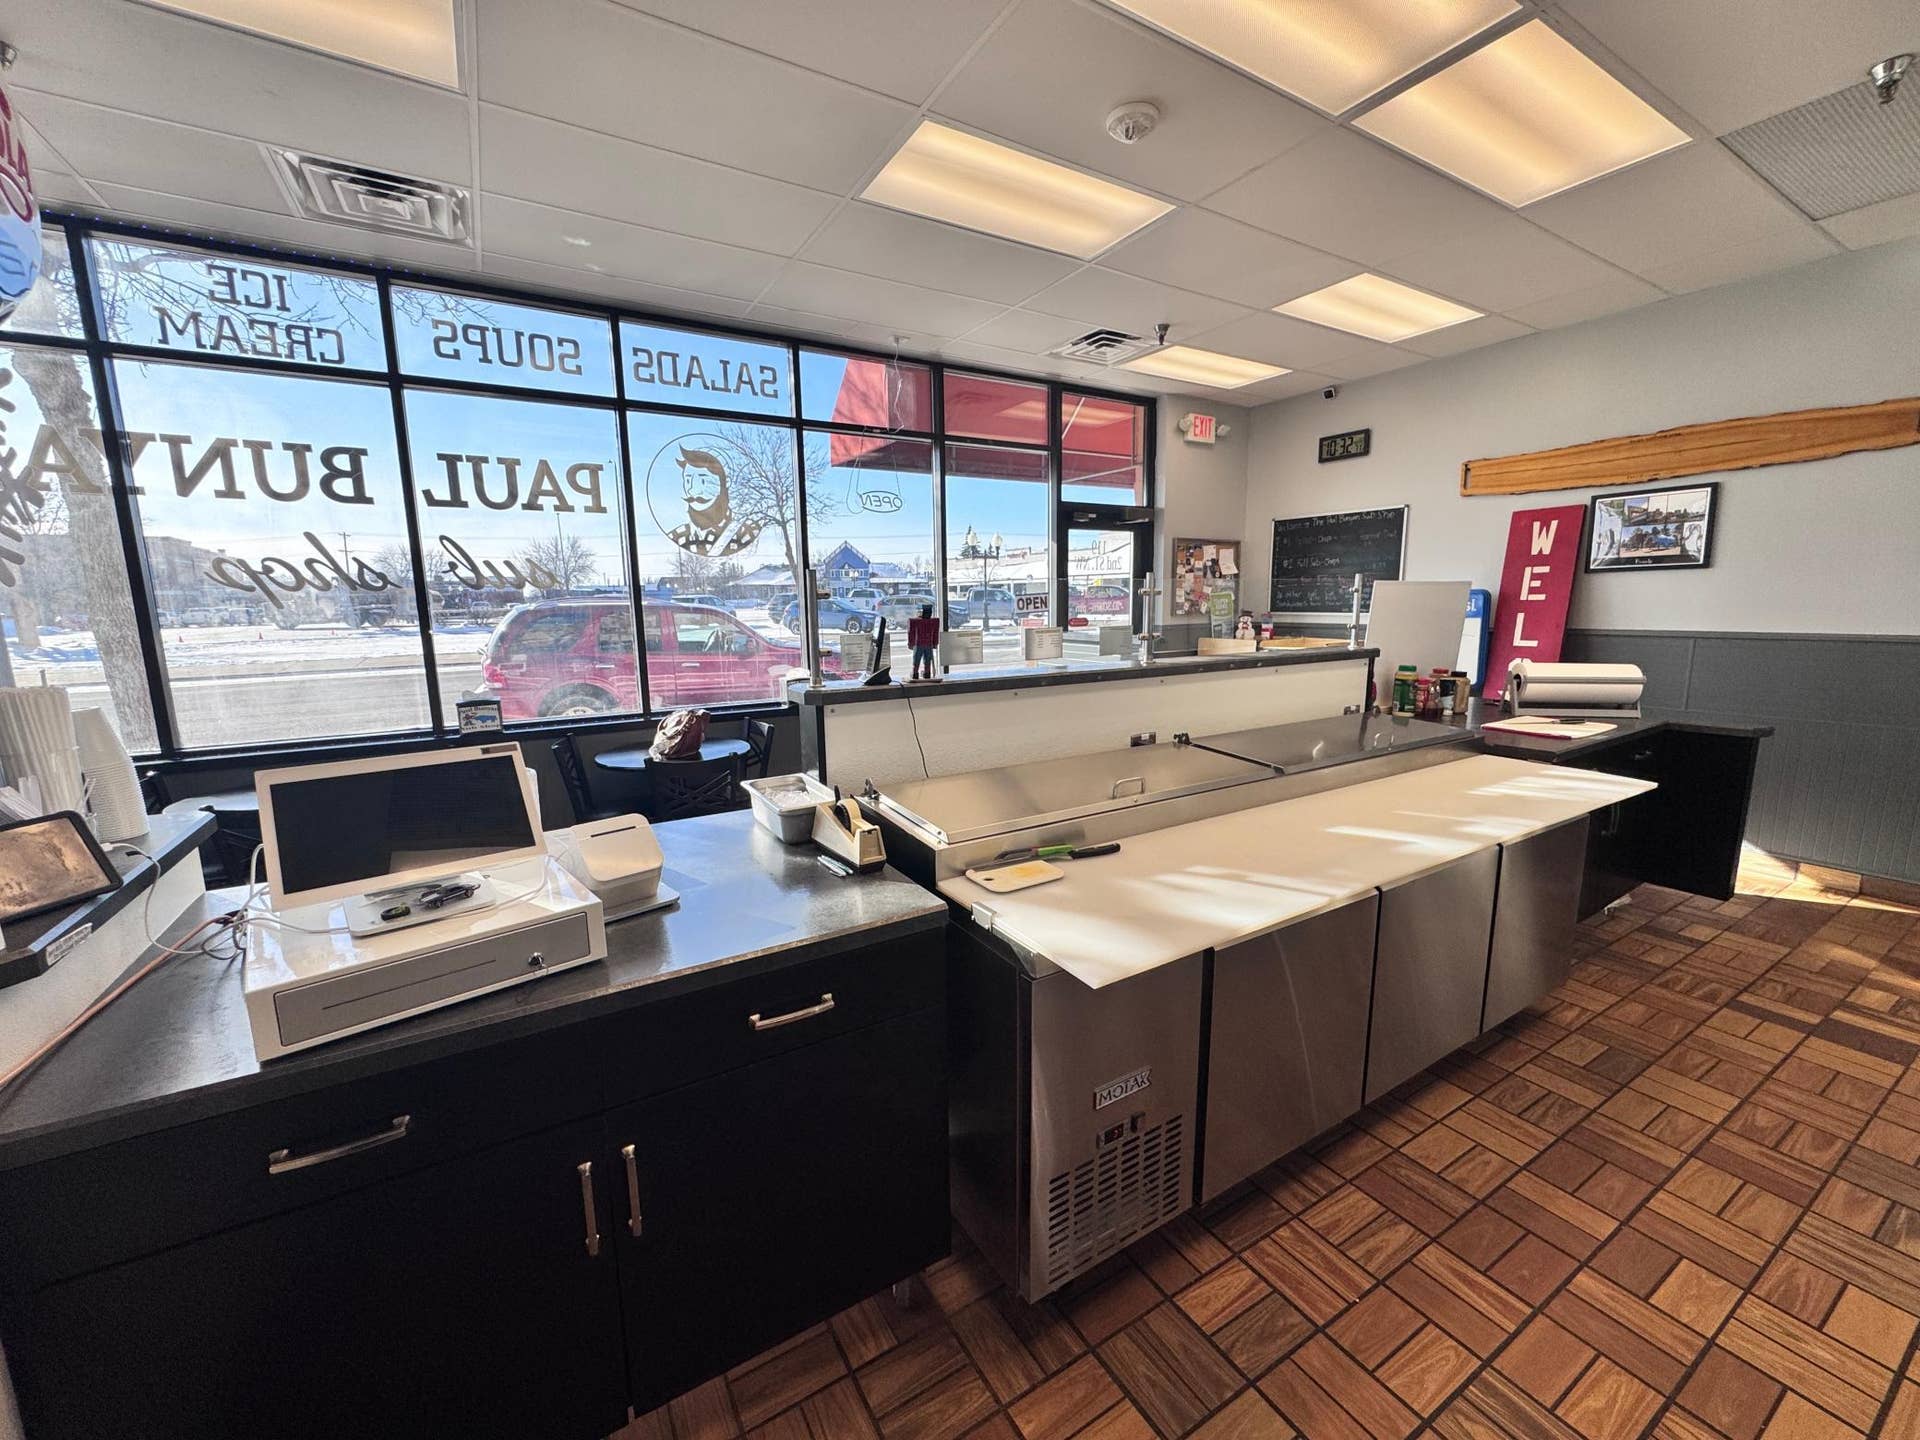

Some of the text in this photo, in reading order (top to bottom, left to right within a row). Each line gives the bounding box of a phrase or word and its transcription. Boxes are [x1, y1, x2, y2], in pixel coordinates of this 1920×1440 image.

[1193, 415, 1213, 438] EXIT
[1017, 596, 1048, 611] OPEN
[1098, 1070, 1151, 1106] MOTAK
